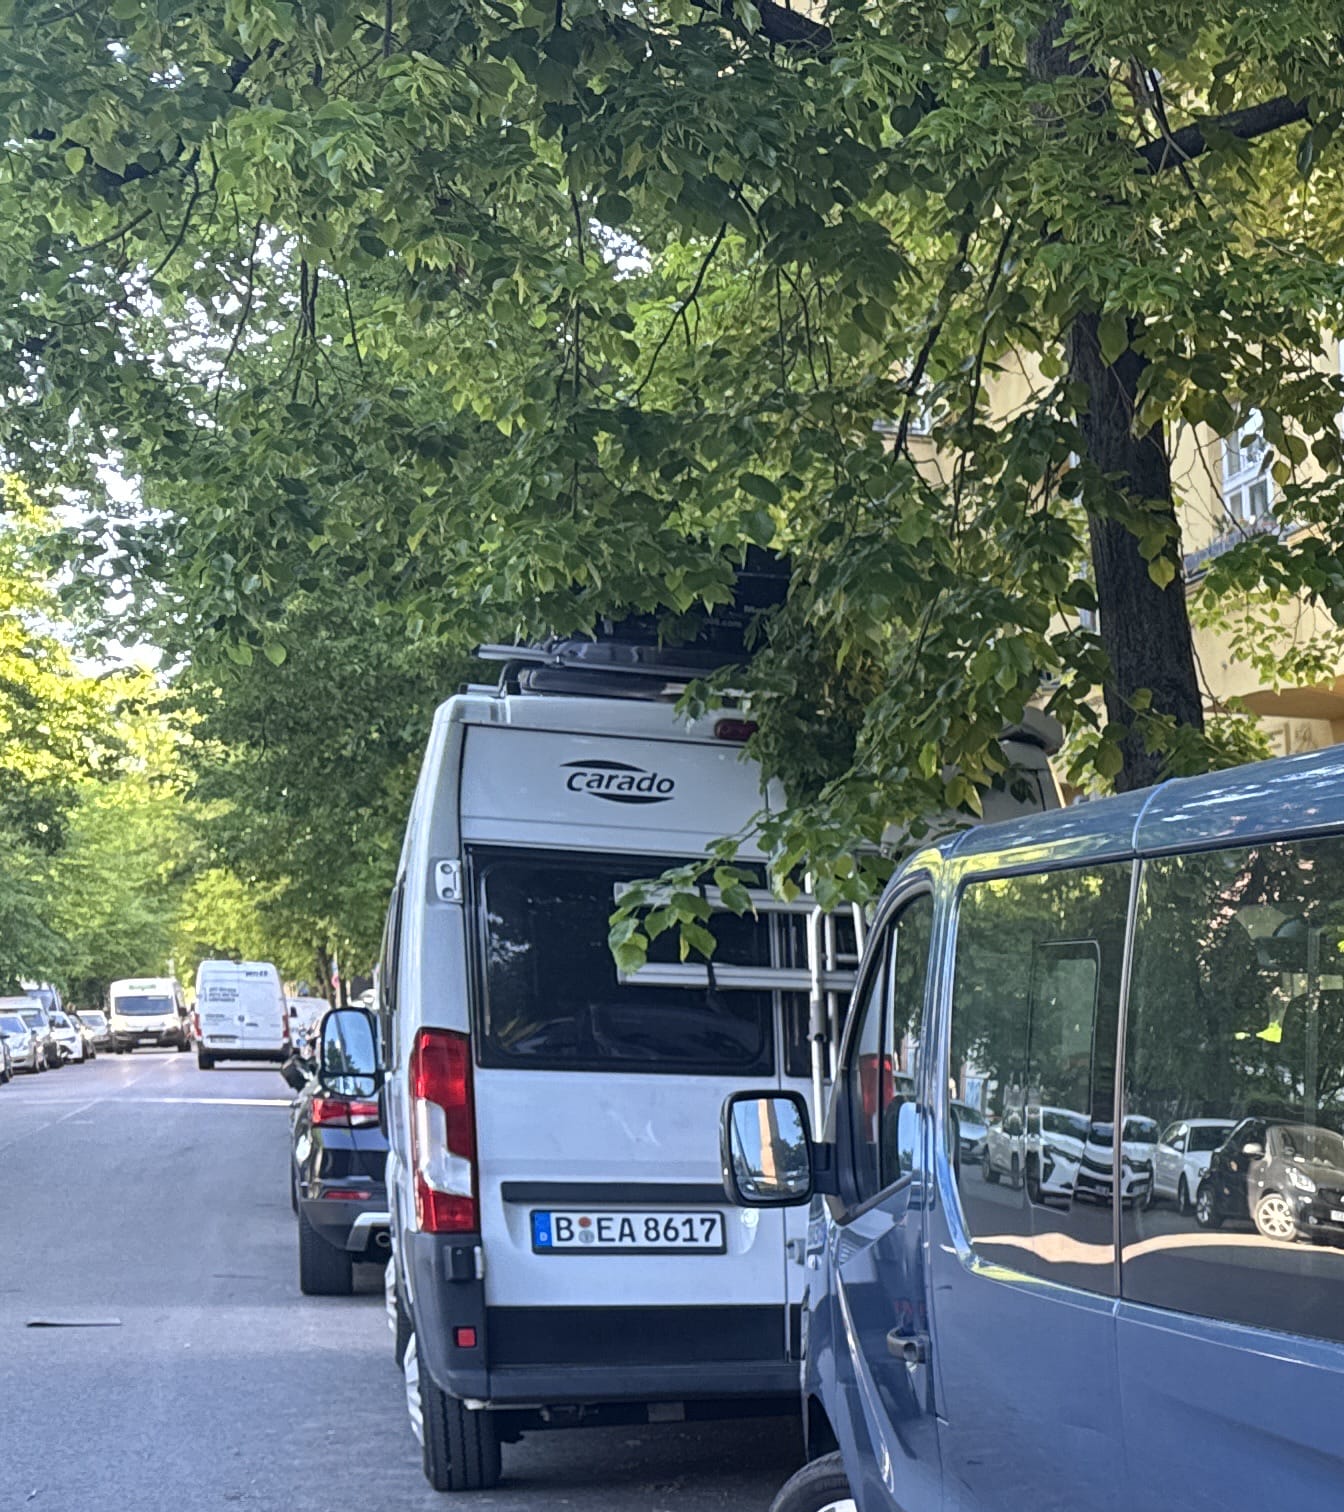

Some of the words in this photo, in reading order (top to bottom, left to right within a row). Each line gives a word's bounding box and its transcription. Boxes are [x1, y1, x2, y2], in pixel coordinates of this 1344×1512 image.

[555, 1217, 575, 1242] B
[596, 1217, 636, 1242] EA
[644, 1217, 717, 1242] 8617
